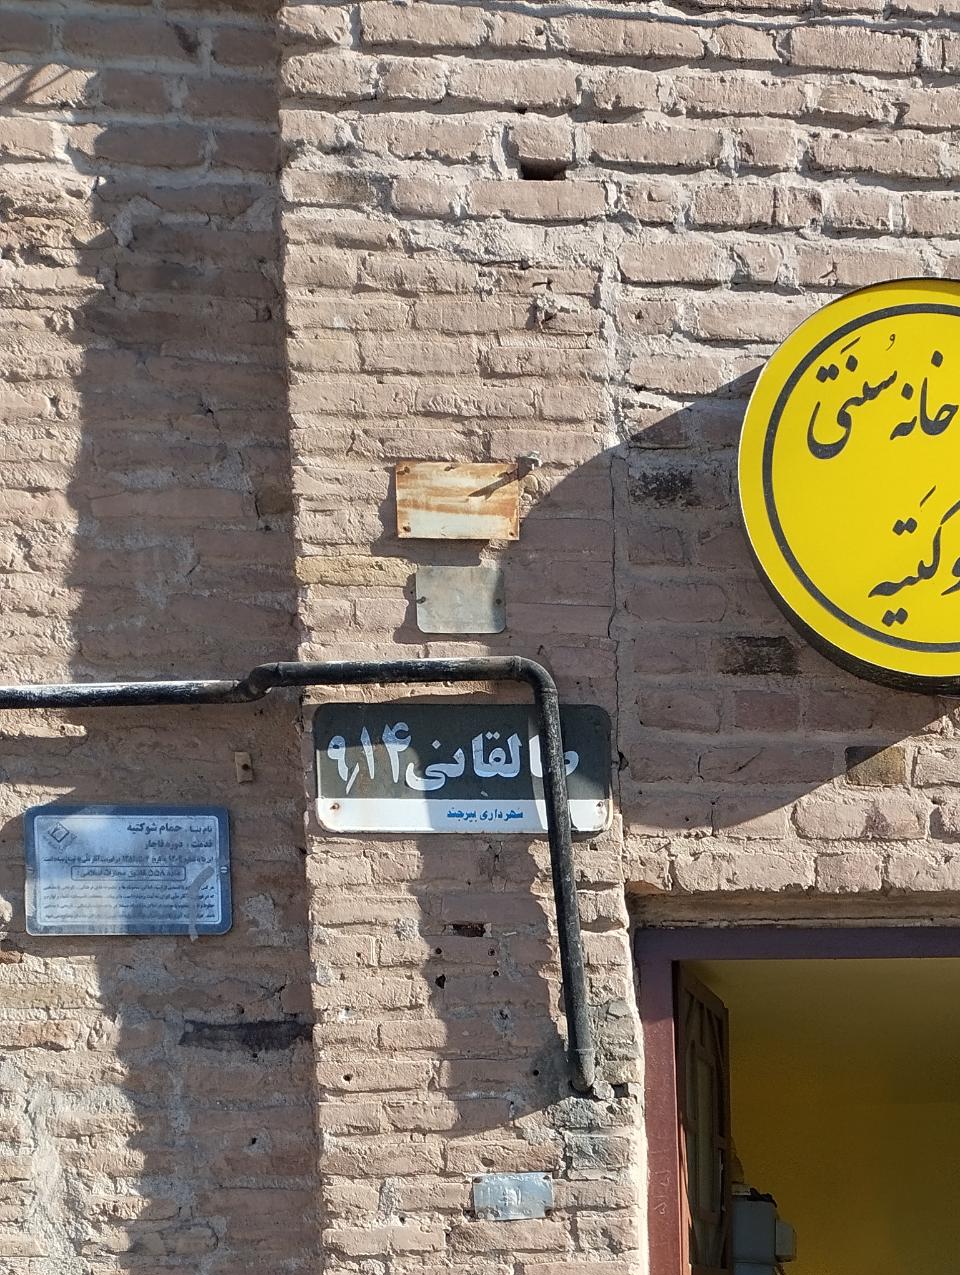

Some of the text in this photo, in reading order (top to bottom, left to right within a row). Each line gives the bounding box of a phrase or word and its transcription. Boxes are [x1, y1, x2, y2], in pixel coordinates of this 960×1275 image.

[890, 350, 959, 440] خانه
[447, 807, 524, 823] شهرداری بیرجند
[127, 822, 158, 835] شوکتیه
[159, 822, 182, 835] حمام
